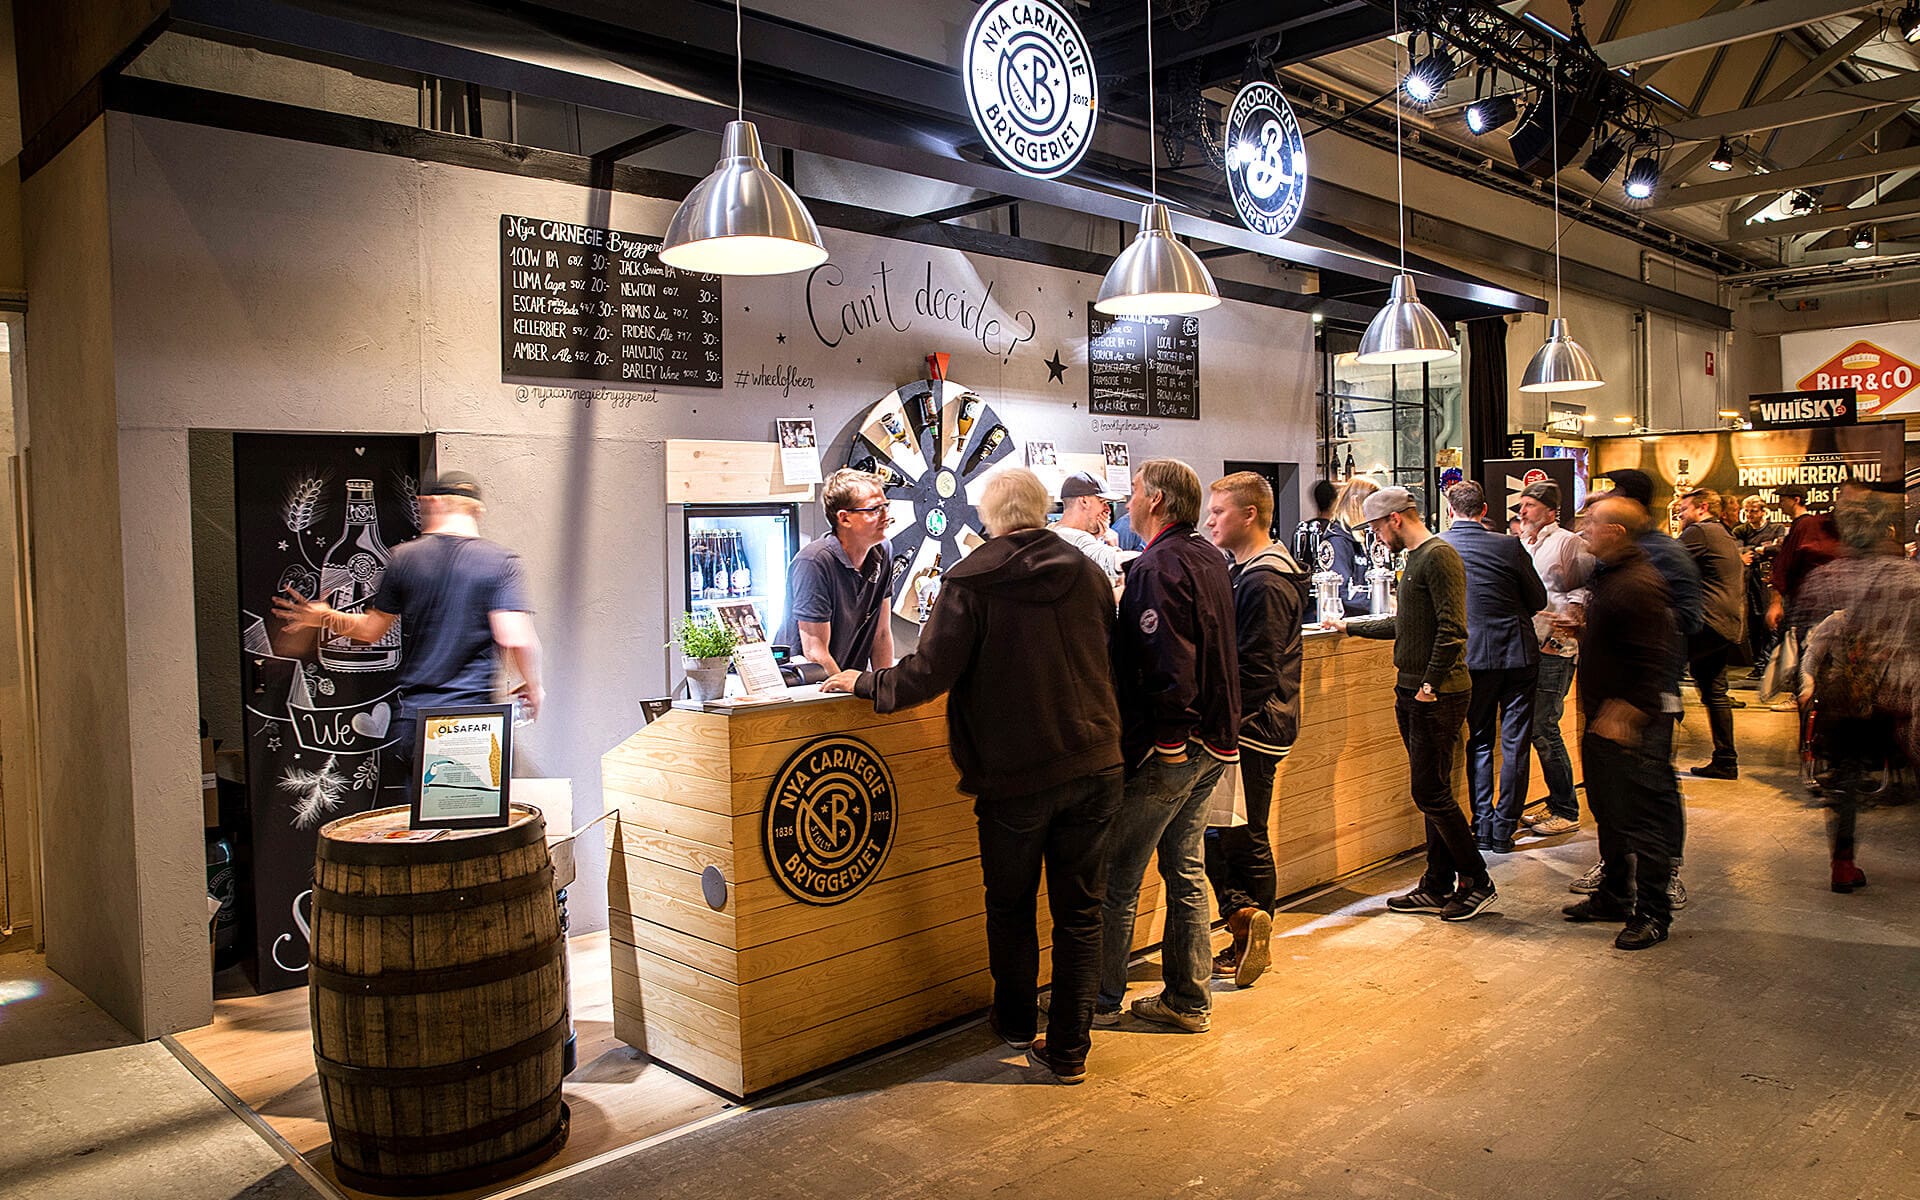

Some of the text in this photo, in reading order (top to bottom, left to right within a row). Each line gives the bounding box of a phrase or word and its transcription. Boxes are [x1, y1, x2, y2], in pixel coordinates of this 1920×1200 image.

[983, 5, 1086, 77] NYA CARNEGIE
[1073, 94, 1089, 107] 2012
[1233, 87, 1296, 134] BROOKLYN
[986, 104, 1080, 162] BRYGGERIET
[1238, 192, 1299, 235] BREWERY
[507, 216, 664, 259] Nya CARNEGIE Bryggeri
[510, 246, 541, 267] 100W
[545, 250, 559, 269] IPA
[619, 259, 642, 276] JACK
[664, 266, 677, 279] IPA
[513, 270, 542, 290] LUMA
[544, 273, 567, 296] lager
[620, 282, 656, 297] NEWTON
[512, 294, 546, 314] ESCAPE
[621, 303, 651, 319] PRIMUS
[807, 261, 1037, 364] Can't decide?
[513, 318, 567, 339] KELLERBIER
[622, 324, 657, 340] FRIDENS
[656, 327, 674, 342] Ale
[513, 342, 550, 362] AMBER
[551, 347, 573, 363] Ale
[622, 363, 658, 379] BARLEY
[659, 365, 680, 380] Wine
[734, 364, 815, 398] #wheelofbeer
[1816, 366, 1913, 392] BIER&CO
[1508, 438, 1525, 459] sin
[1738, 463, 1882, 487] PRENUMERERA NU!
[302, 712, 356, 746] We
[780, 749, 885, 810] NYA CARNEGIE
[873, 810, 890, 822] 2012
[775, 825, 794, 838] 1836
[810, 825, 832, 851] STHLM
[785, 838, 881, 893] BRYGGERIET
